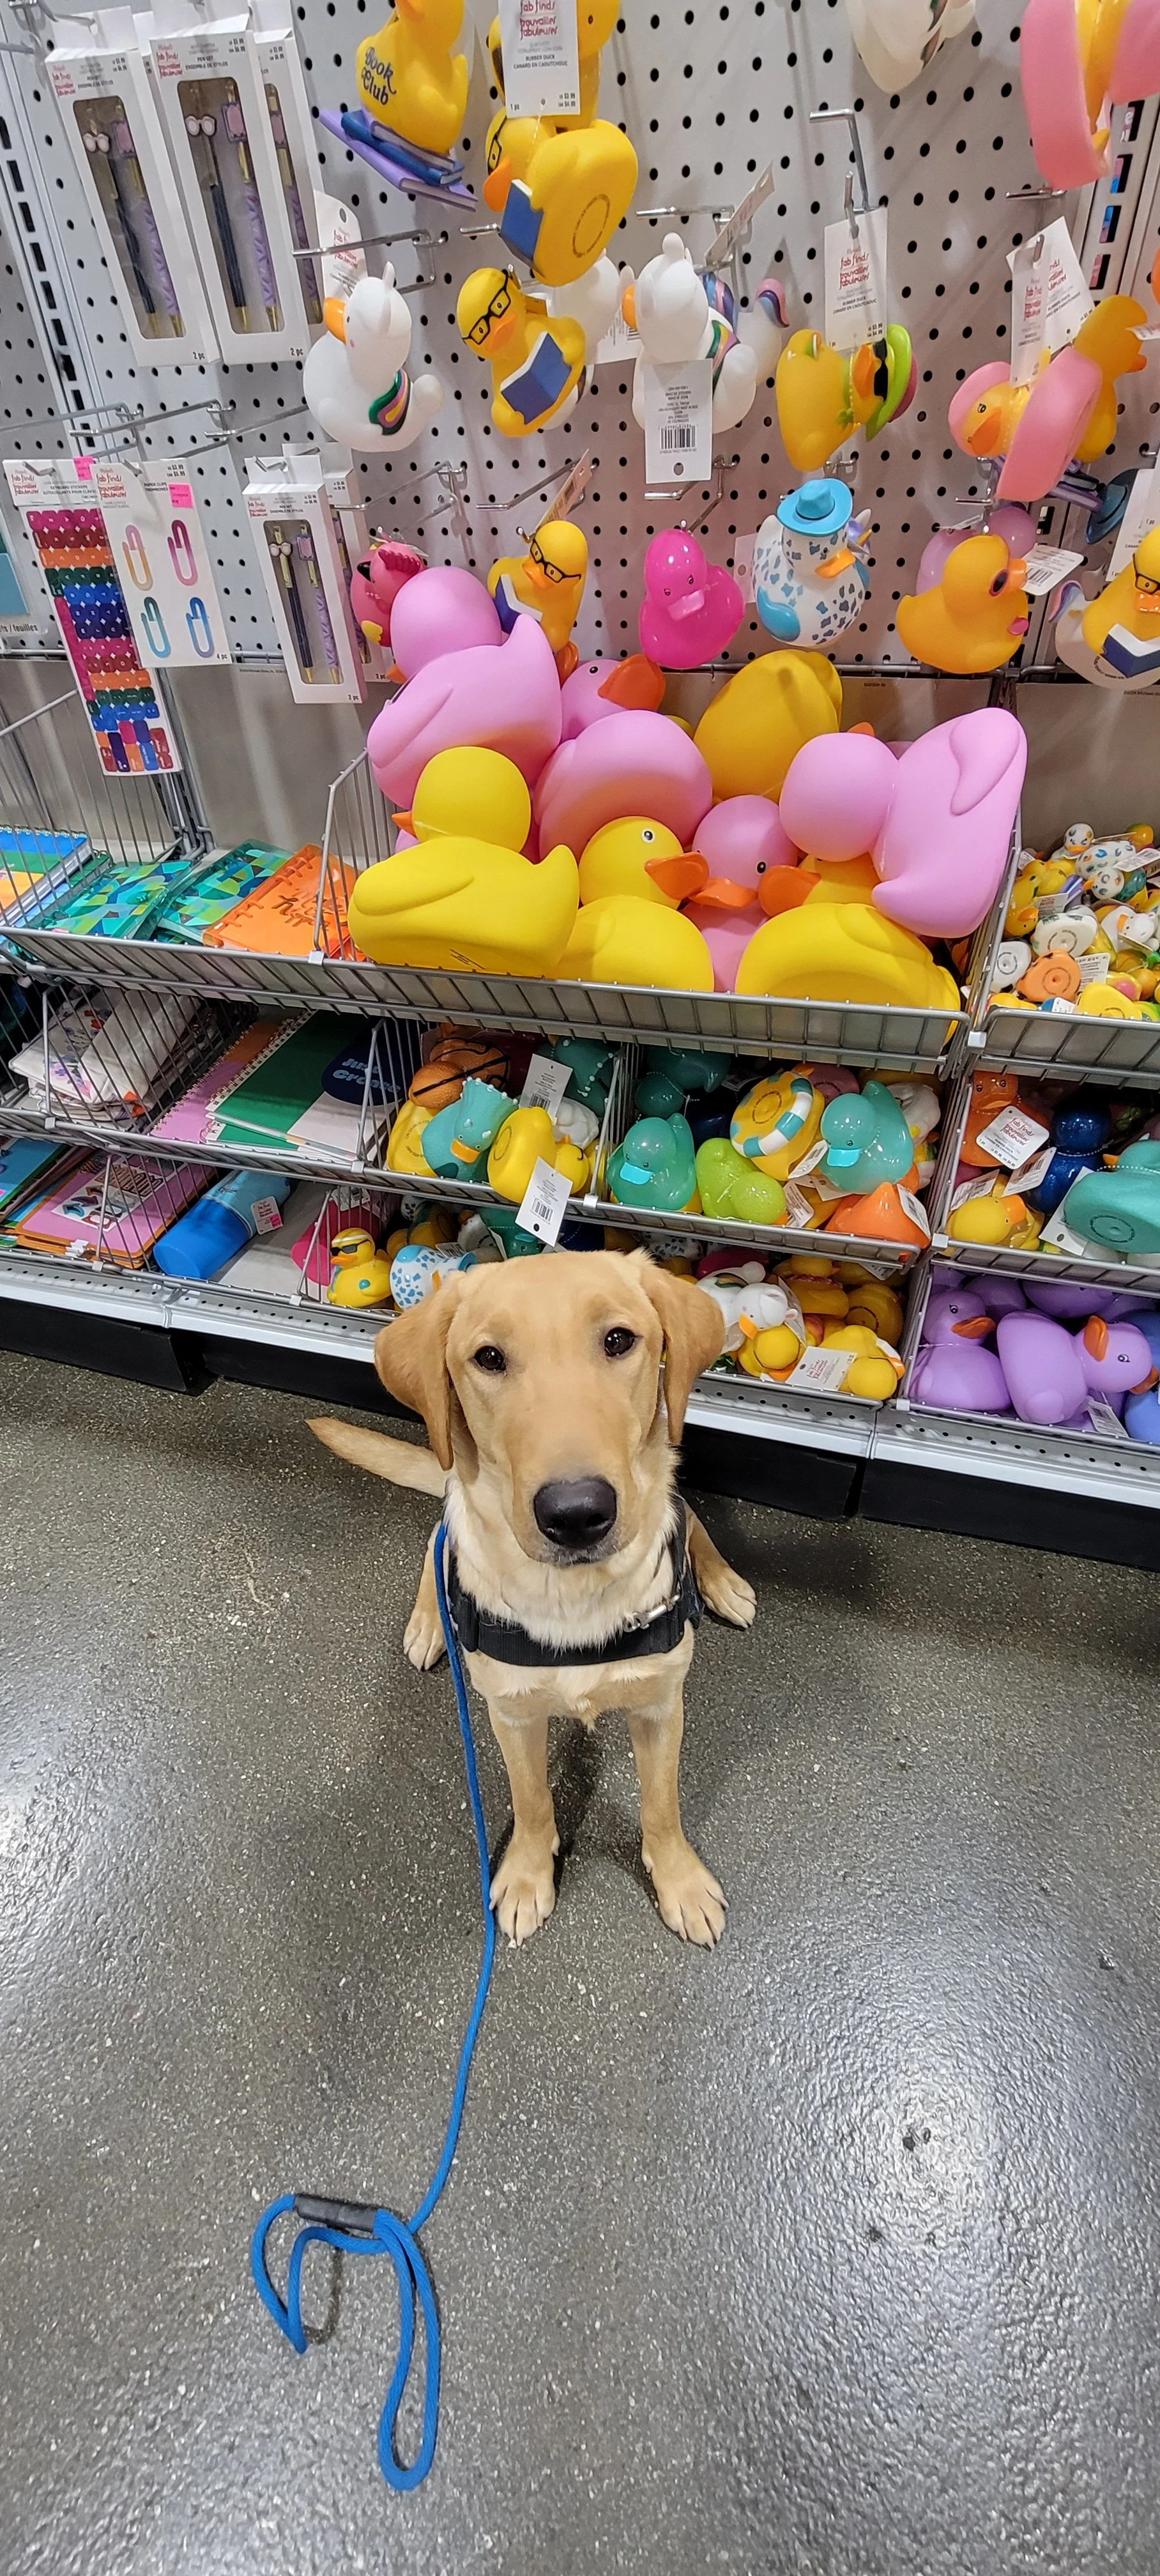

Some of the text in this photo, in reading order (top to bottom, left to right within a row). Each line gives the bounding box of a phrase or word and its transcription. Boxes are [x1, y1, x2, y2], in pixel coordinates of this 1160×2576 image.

[362, 66, 388, 105] Club
[365, 47, 397, 95] Book
[13, 623, 38, 632] feuilles
